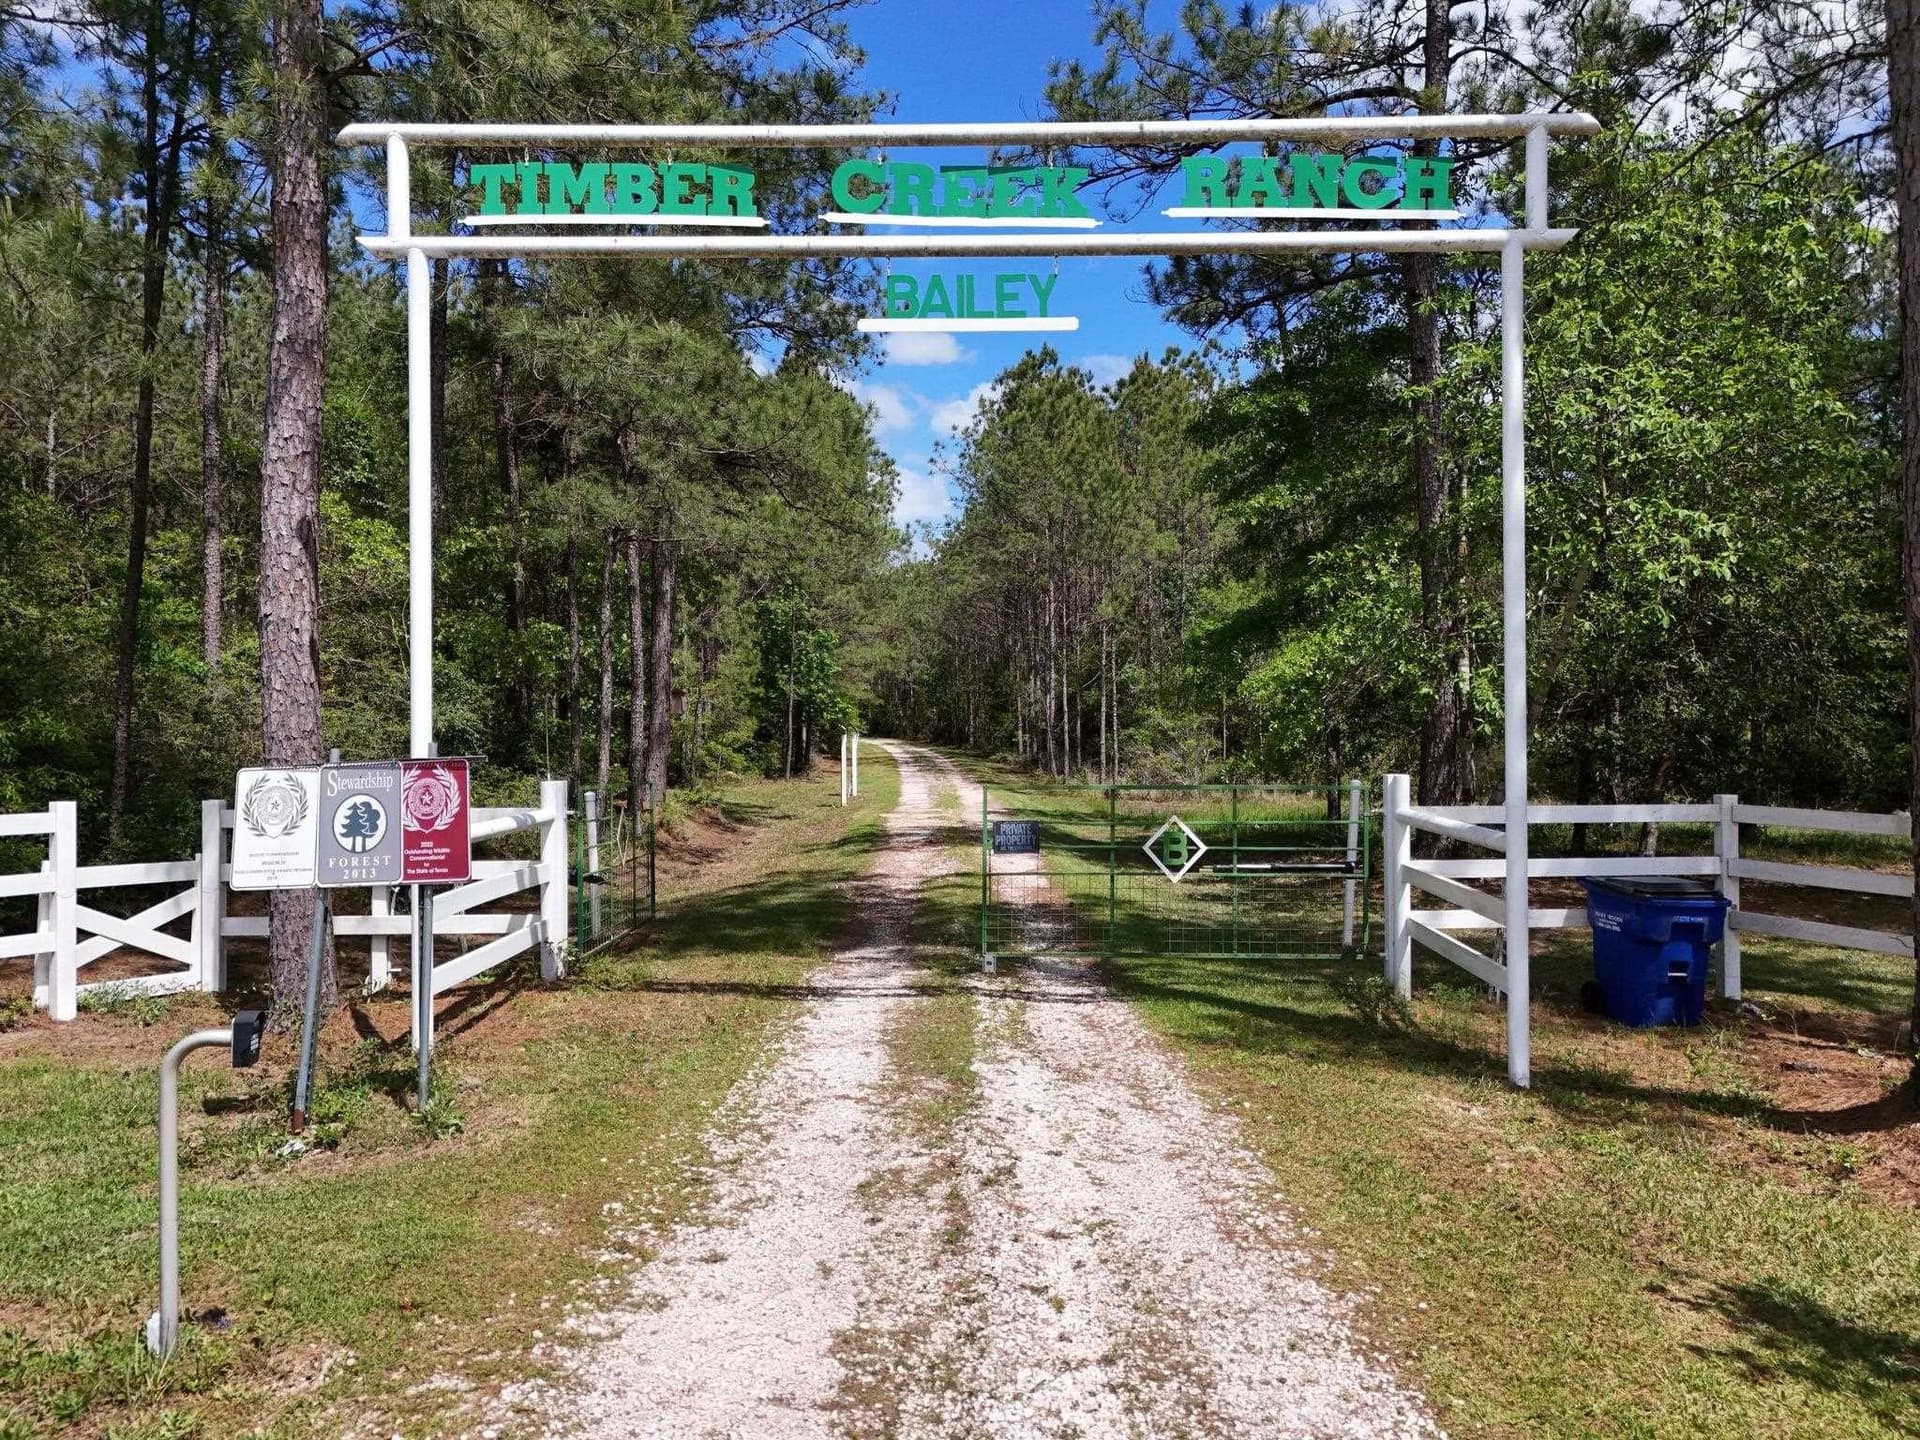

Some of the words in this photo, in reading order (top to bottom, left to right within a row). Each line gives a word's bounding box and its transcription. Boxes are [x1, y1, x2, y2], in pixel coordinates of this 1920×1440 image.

[470, 162, 757, 216] TIMBER
[831, 159, 1089, 218] CREEK
[1180, 154, 1455, 210] RANCH
[886, 273, 1057, 319] BAILEY
[327, 769, 393, 797] Stewardship
[1000, 823, 1032, 834] PRIVATE
[995, 834, 1037, 846] PROPERTY
[1162, 831, 1188, 866] B
[329, 855, 391, 868] FOREST
[343, 868, 376, 880] 2013
